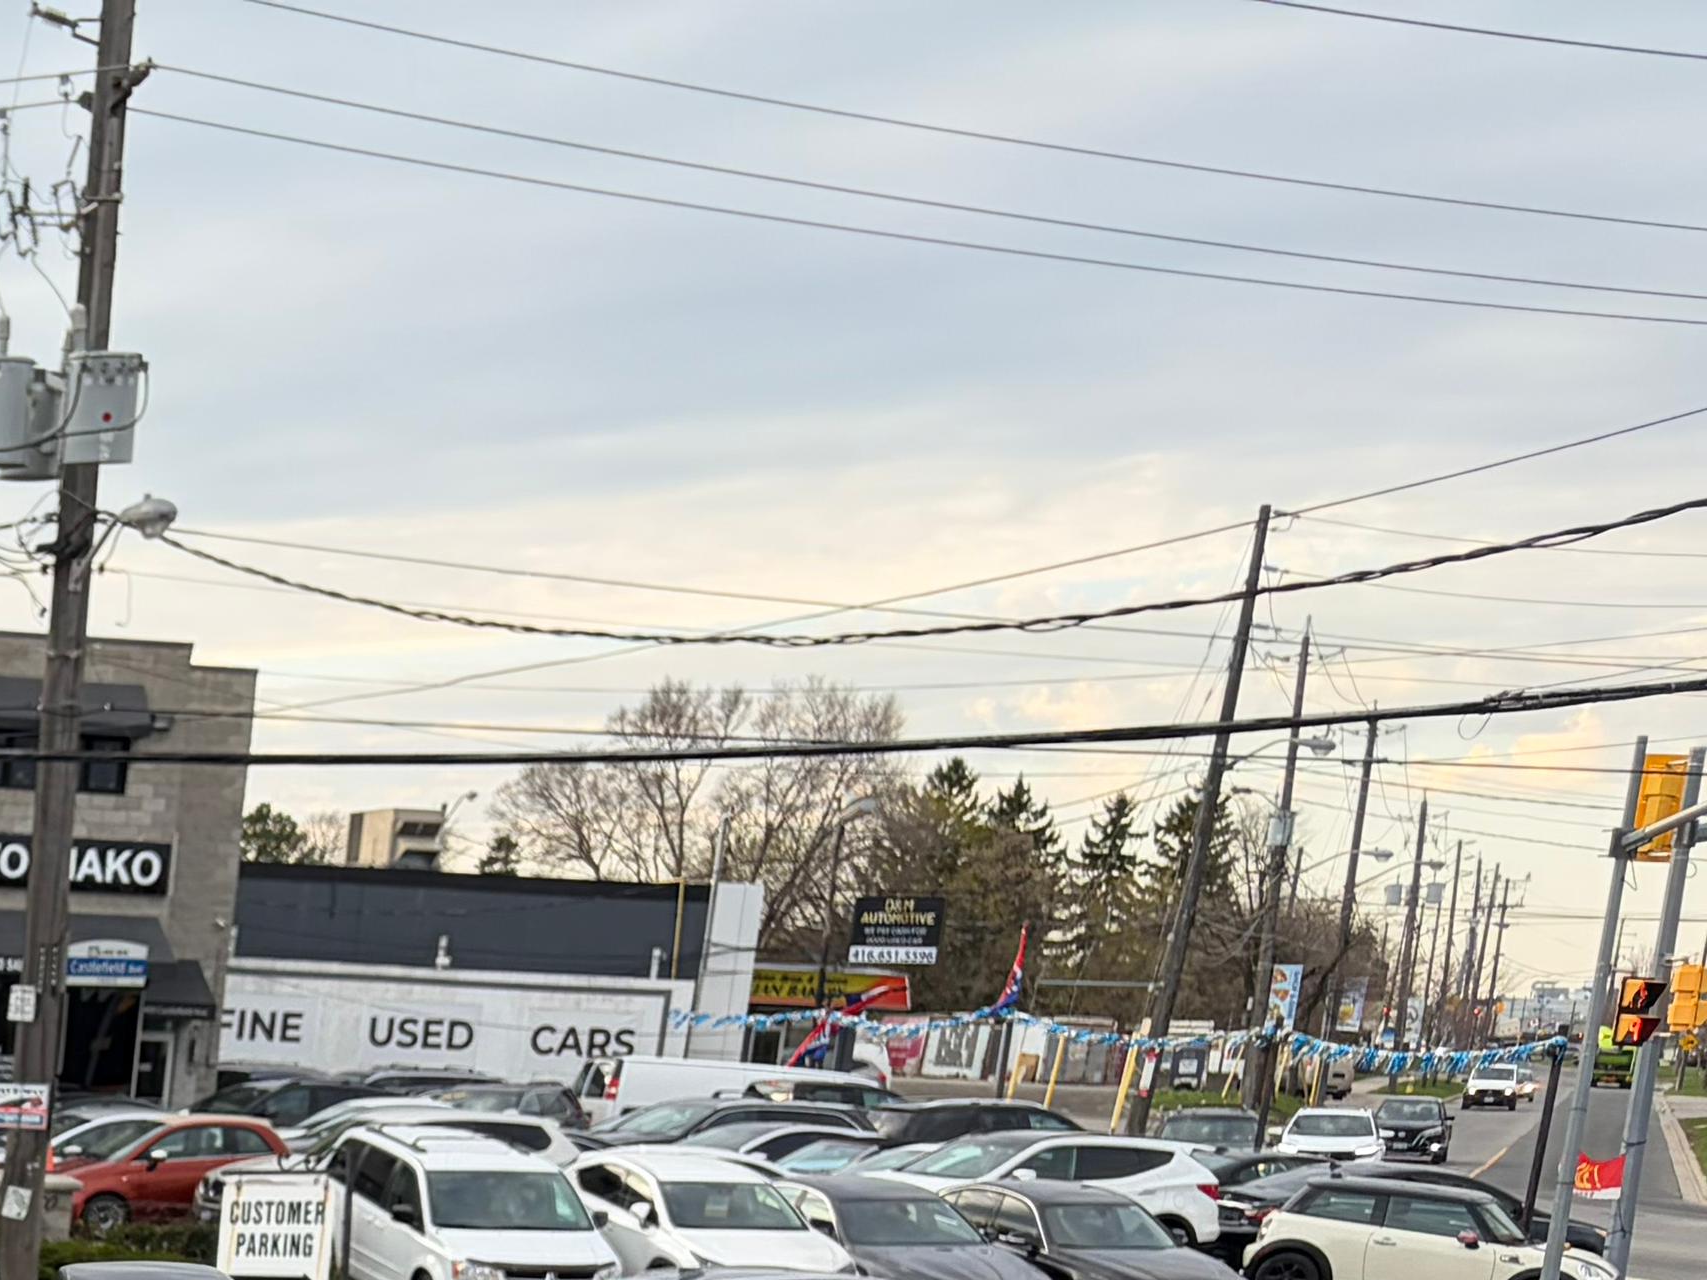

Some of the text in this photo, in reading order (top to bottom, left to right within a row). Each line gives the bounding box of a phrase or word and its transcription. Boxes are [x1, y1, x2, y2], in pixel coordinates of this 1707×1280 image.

[860, 911, 936, 926] AUTOMOTIVE
[368, 1015, 475, 1051] USED
[530, 1024, 636, 1058] CARS
[230, 1200, 326, 1258] CUSTOMER PARKING
